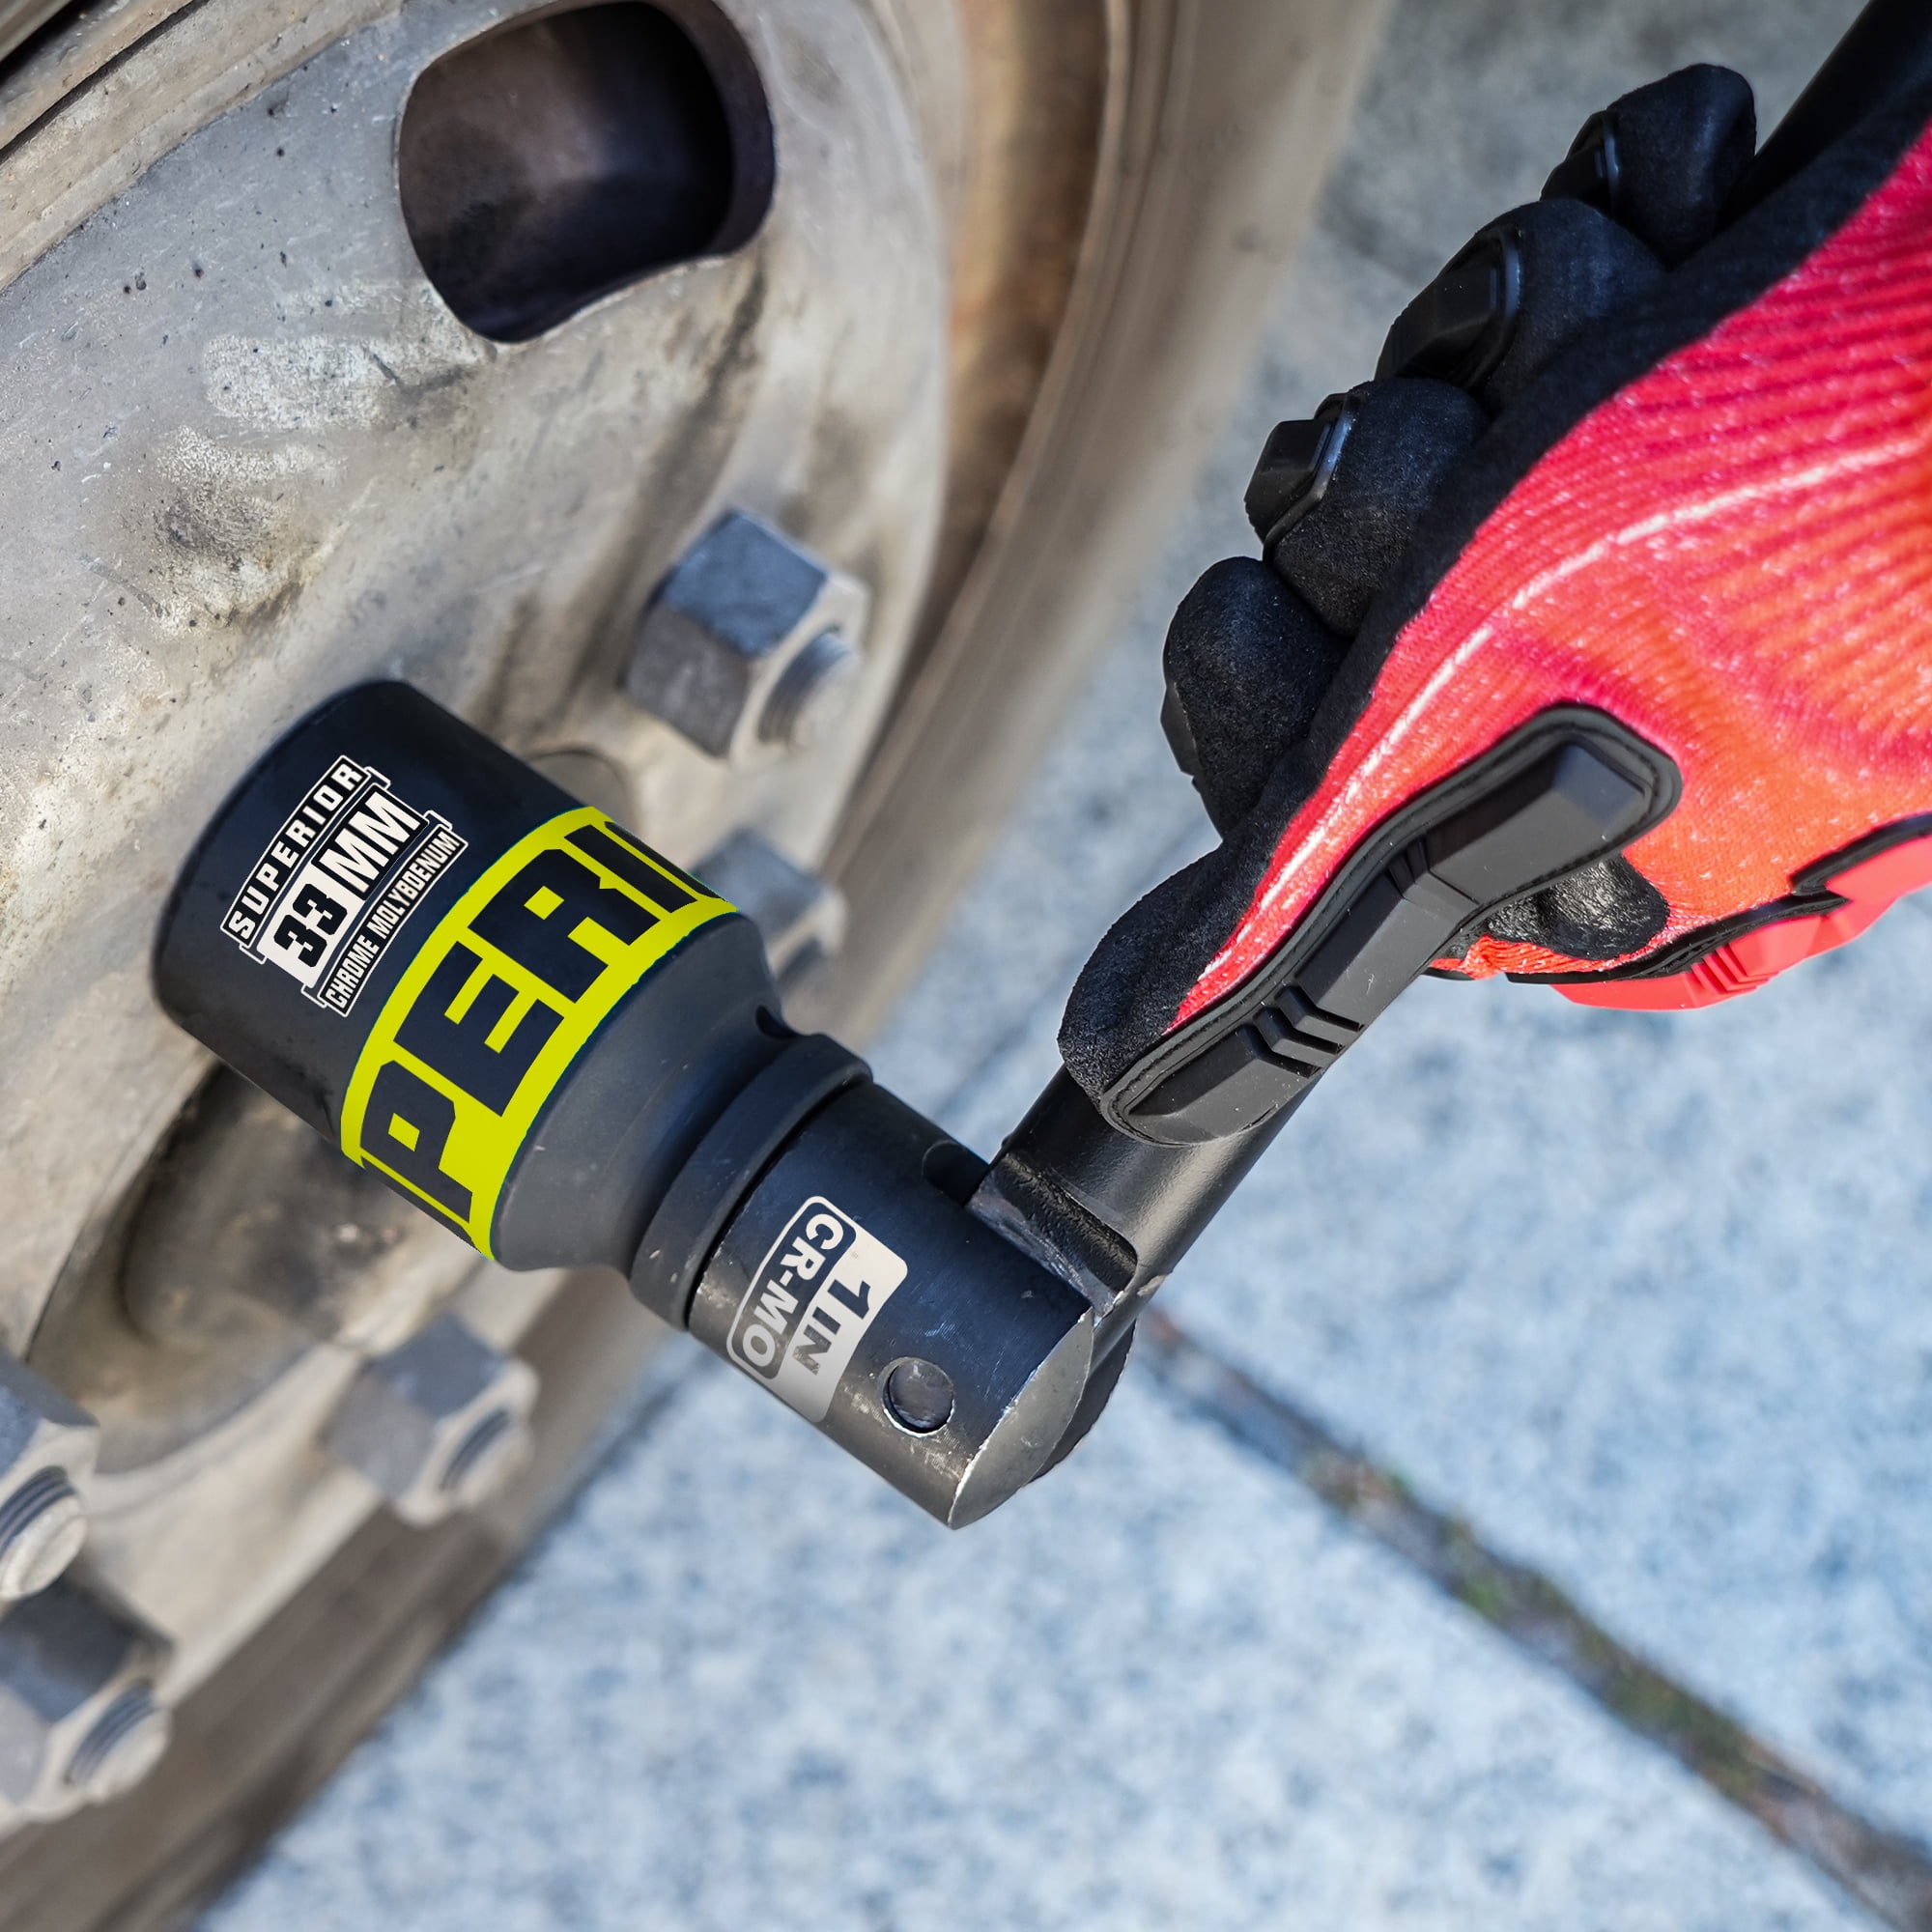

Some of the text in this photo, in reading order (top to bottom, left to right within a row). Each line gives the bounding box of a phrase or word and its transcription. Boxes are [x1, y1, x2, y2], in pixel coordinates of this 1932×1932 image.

[228, 763, 362, 939] SUPERIOR
[326, 831, 461, 1009] CHROME MOLYBDENUM
[358, 821, 726, 1254] PERI
[742, 1213, 844, 1367] CR-MO
